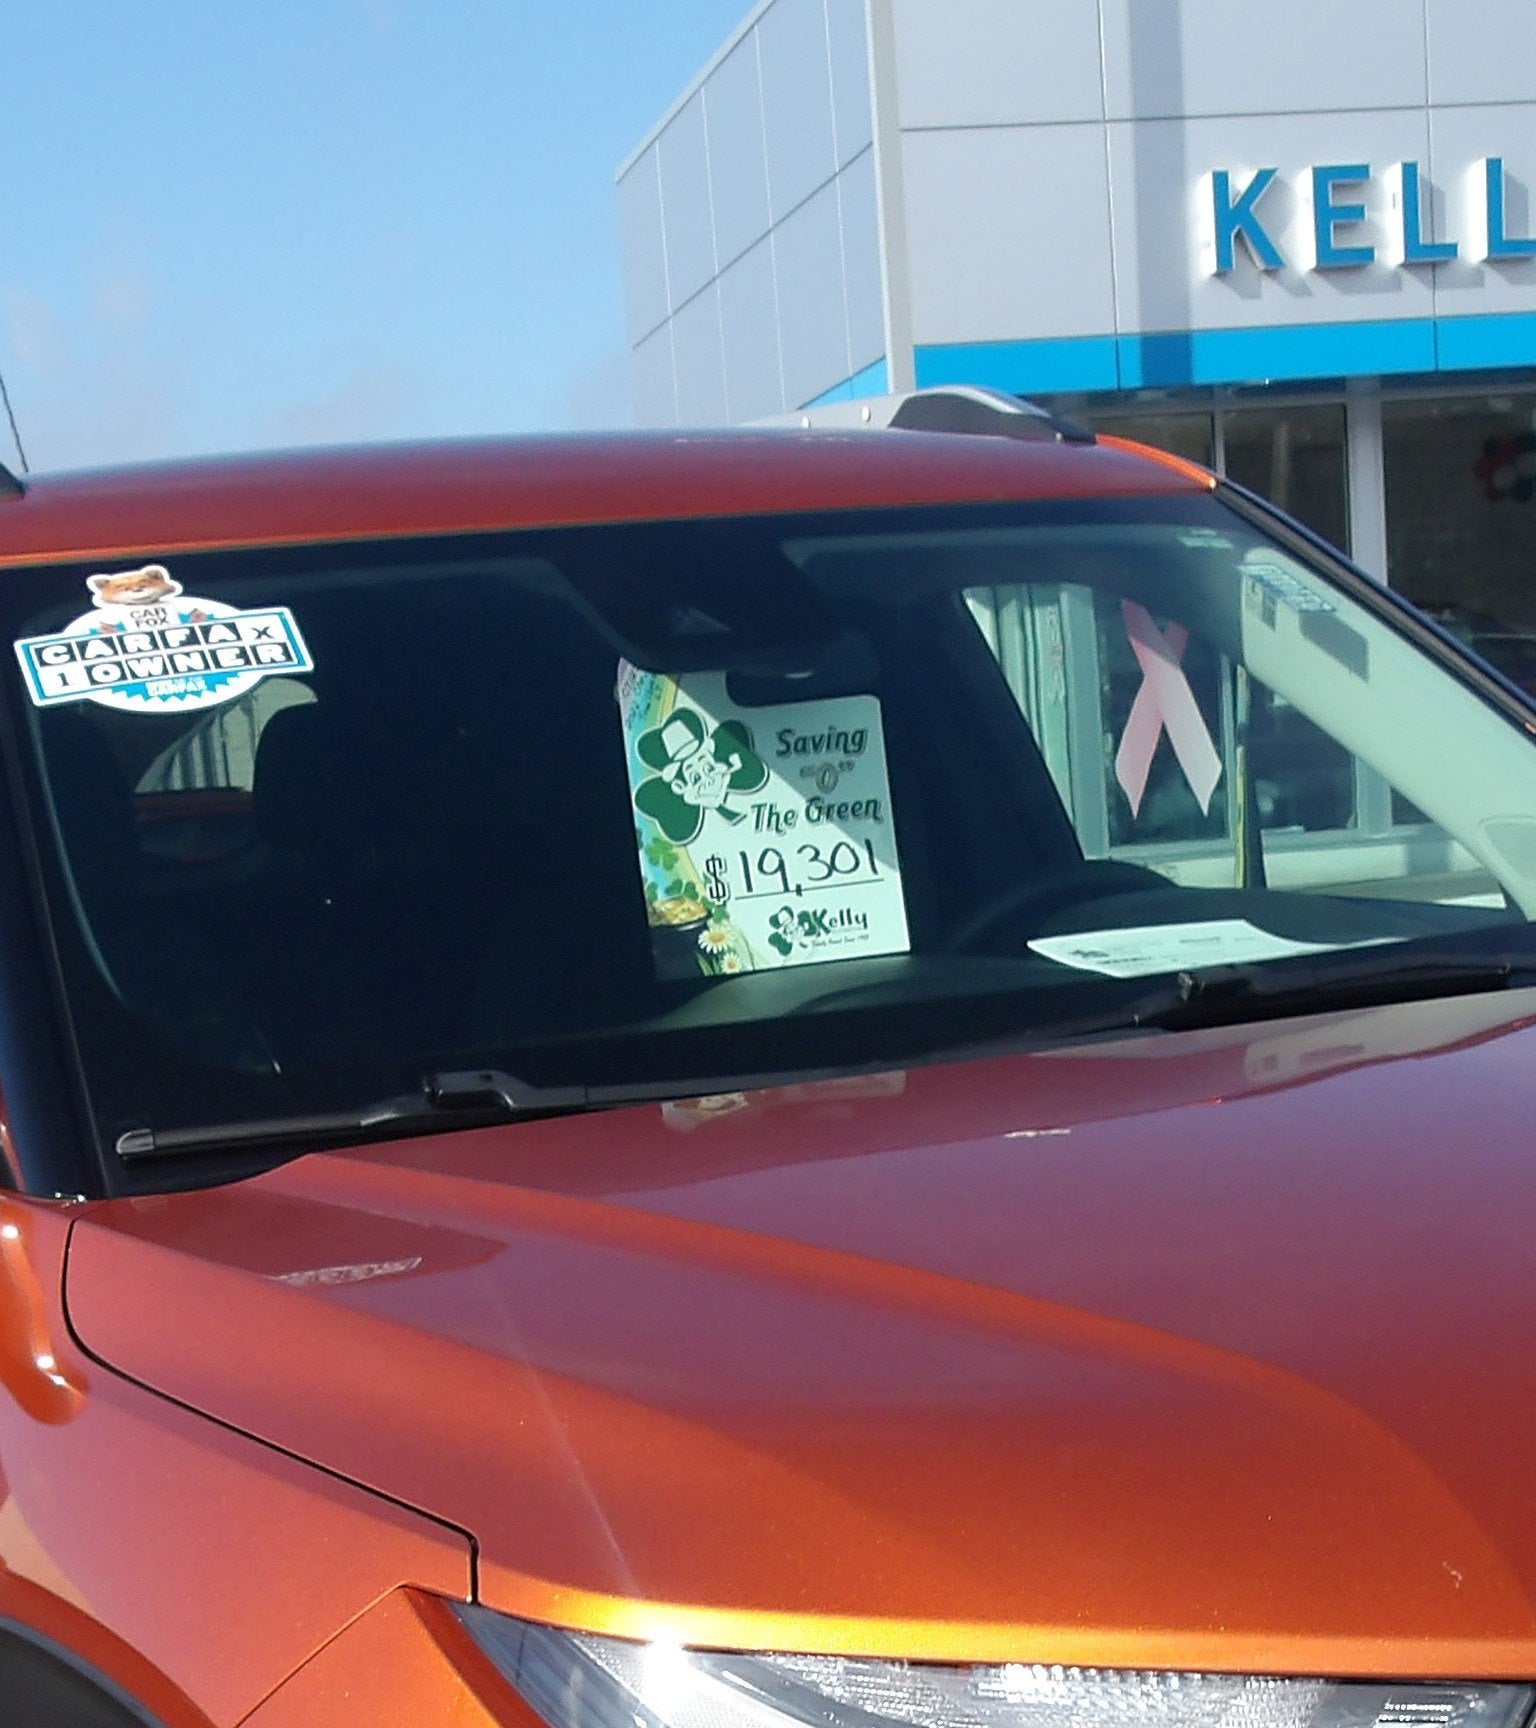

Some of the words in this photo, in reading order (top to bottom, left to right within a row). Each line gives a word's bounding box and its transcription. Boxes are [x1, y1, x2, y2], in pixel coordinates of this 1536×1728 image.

[38, 622, 274, 667] CARFAX
[84, 643, 286, 684] OWNER
[775, 725, 868, 757] Saving
[751, 801, 799, 835] The
[805, 797, 884, 825] Green
[811, 907, 868, 937] Kelly
